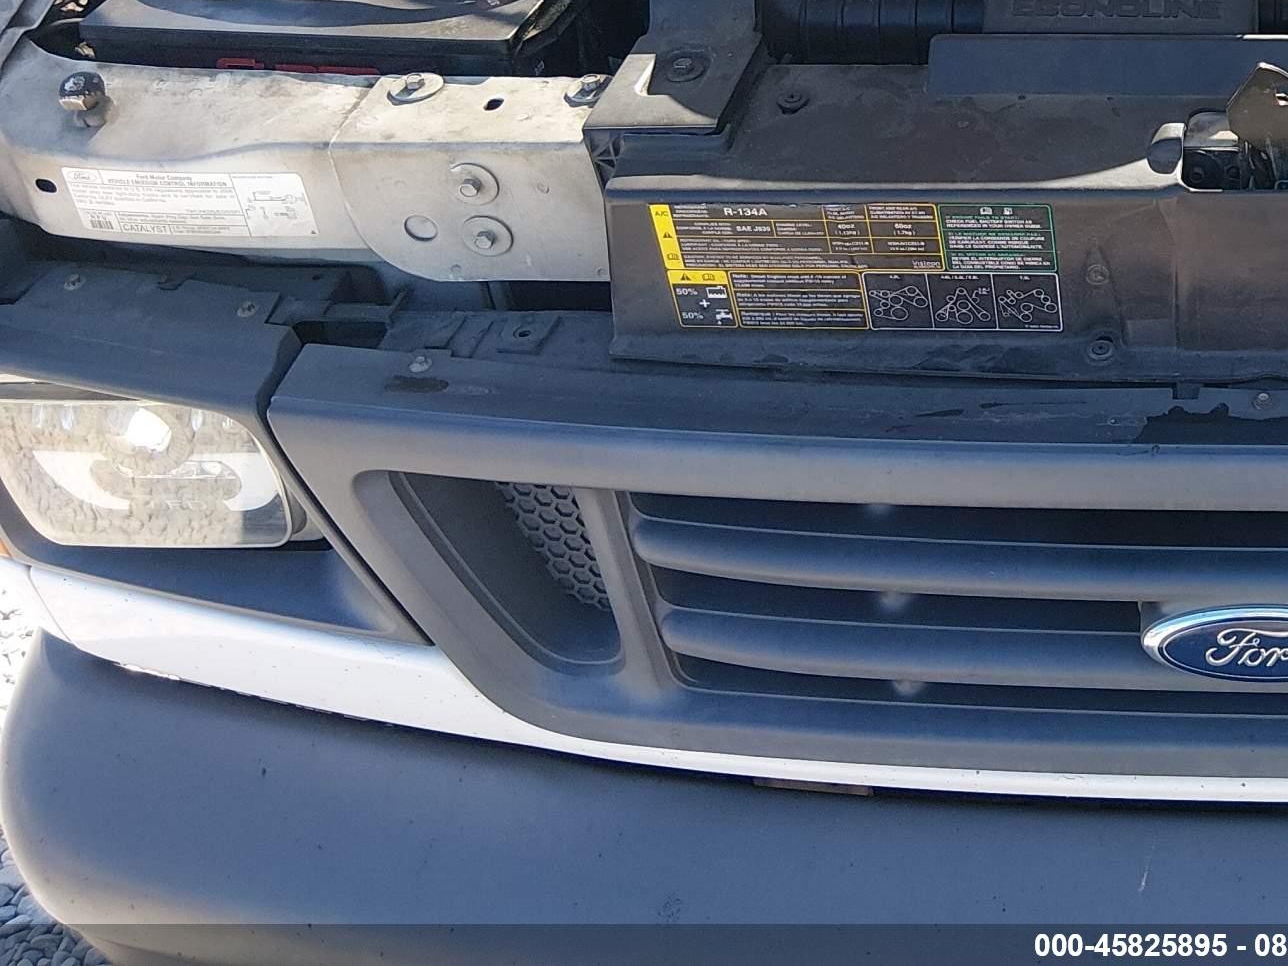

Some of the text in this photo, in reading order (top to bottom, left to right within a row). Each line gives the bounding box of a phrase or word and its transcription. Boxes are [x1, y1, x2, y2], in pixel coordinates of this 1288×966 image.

[723, 207, 768, 216] R-134A
[122, 224, 168, 234] CATALYST
[676, 287, 698, 295] 50%
[682, 312, 704, 320] 50%
